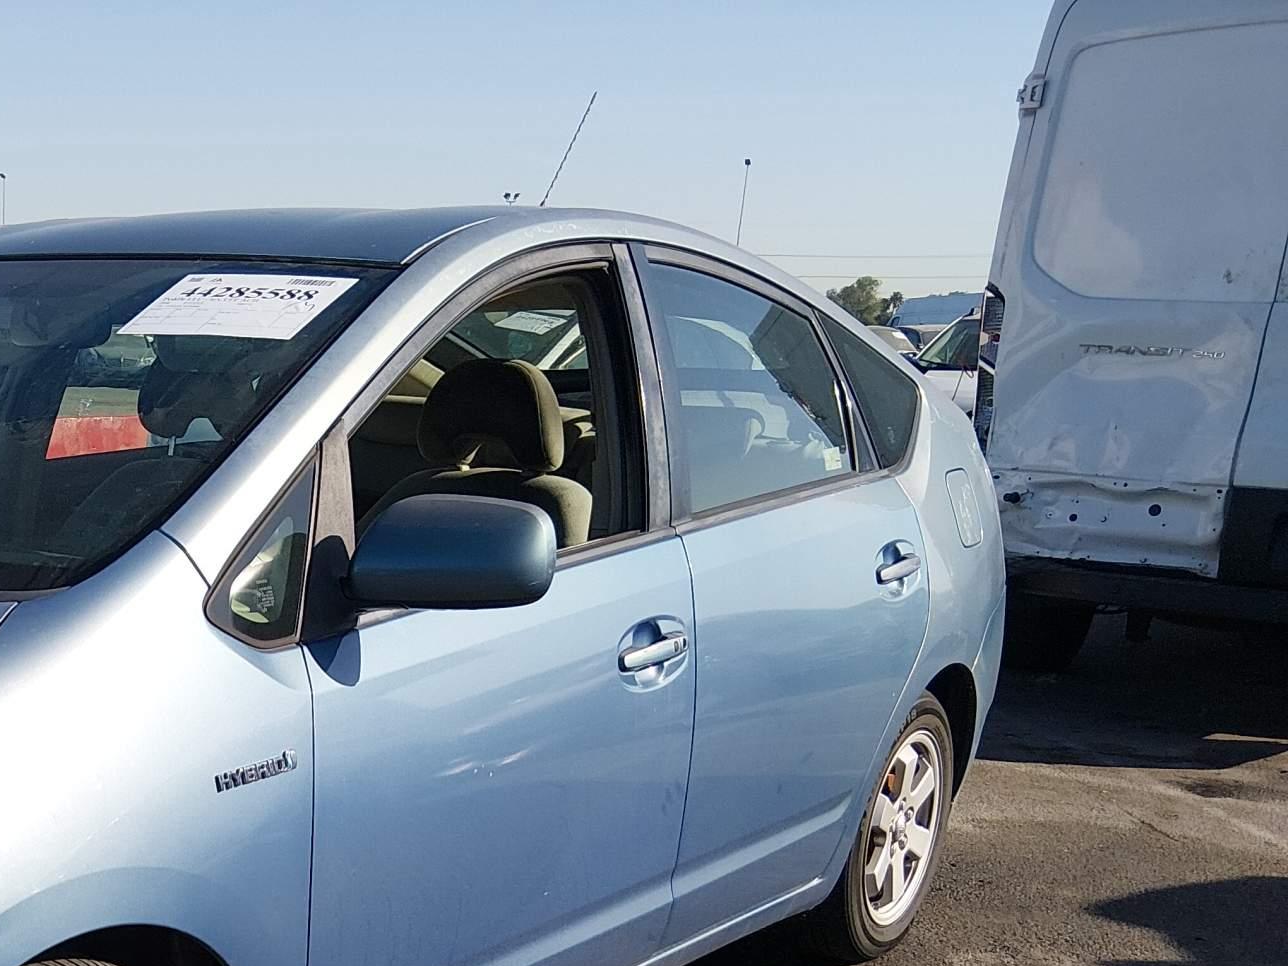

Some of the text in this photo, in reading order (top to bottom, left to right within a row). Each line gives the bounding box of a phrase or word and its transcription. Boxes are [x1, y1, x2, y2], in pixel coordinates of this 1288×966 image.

[181, 286, 320, 301] 44285588
[1079, 344, 1192, 357] TRANSIT
[214, 751, 295, 794] HYBRID
